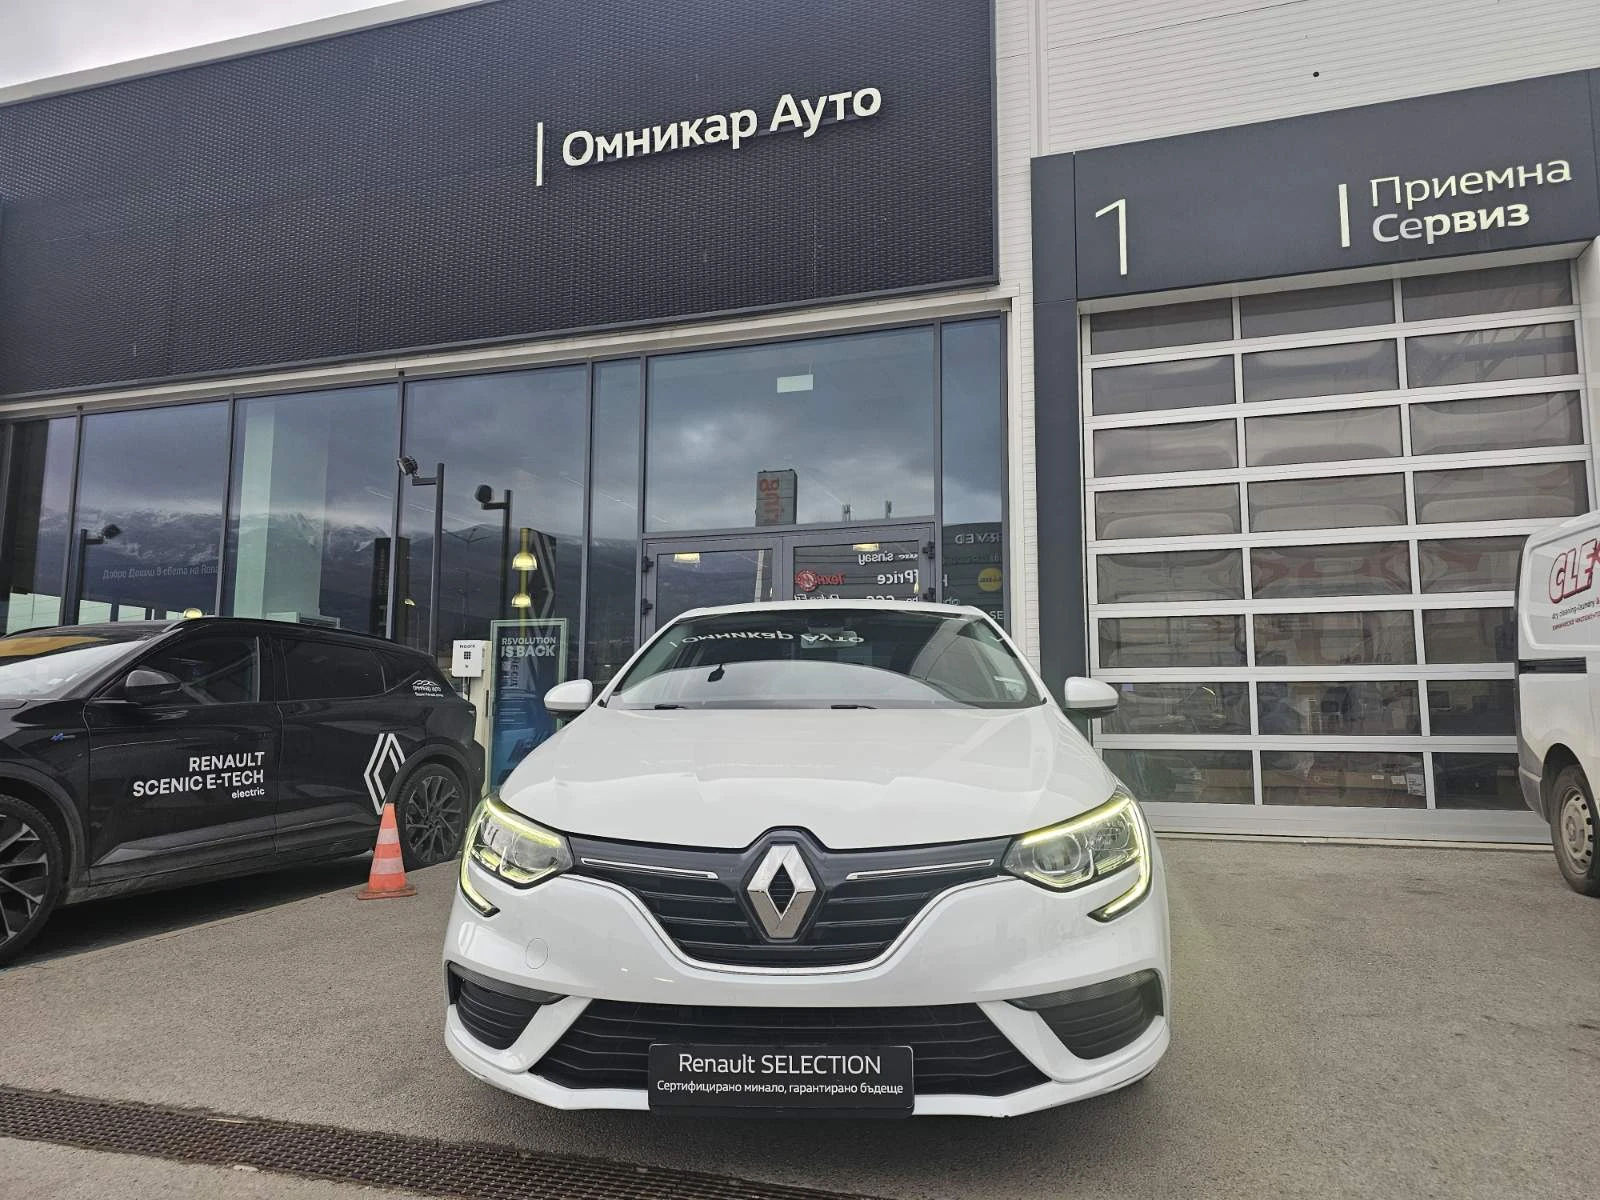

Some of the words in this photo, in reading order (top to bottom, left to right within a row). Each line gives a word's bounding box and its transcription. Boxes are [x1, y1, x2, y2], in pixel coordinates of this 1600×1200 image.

[562, 108, 758, 167] Омникар
[769, 87, 882, 139] Ауто
[1370, 159, 1572, 211] Приемна
[1372, 203, 1530, 245] Сервиз
[1095, 199, 1128, 275] 1
[501, 646, 514, 657] IS
[517, 645, 555, 657] BACK
[502, 637, 556, 645] REVOLUTION
[189, 752, 265, 772] RENAULT
[133, 775, 203, 797] SCENIC
[206, 769, 264, 789] E-TECH
[231, 786, 265, 799] electric
[679, 1054, 755, 1073] Renault
[761, 1055, 882, 1074] SELECTION
[657, 1080, 742, 1093] Сертифицирано
[744, 1083, 787, 1094] минало,
[789, 1084, 857, 1095] гарантирано
[860, 1082, 904, 1095] бъдеще
